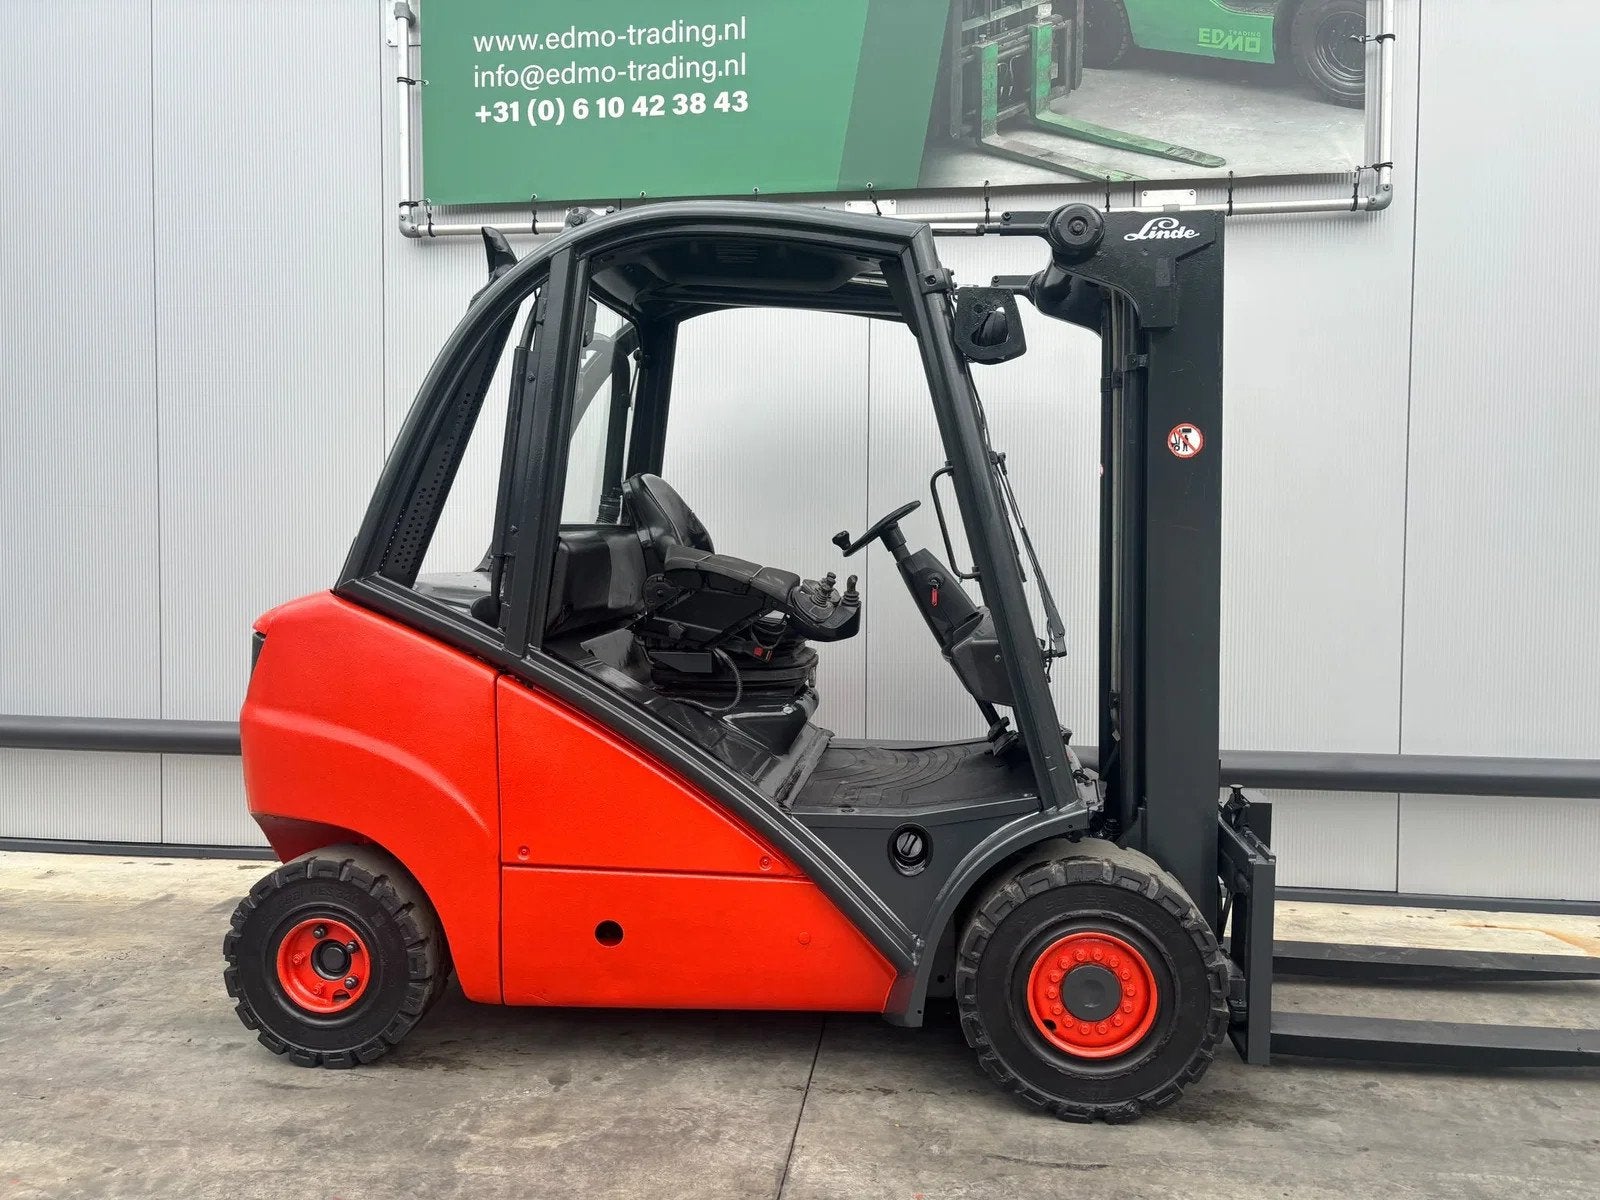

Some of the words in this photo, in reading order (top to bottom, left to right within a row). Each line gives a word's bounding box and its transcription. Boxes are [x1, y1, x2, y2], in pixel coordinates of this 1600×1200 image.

[473, 15, 746, 53] www.edmo-trading.nl
[1197, 27, 1261, 53] EDMO
[474, 51, 746, 91] info@edmo-trading.nl
[475, 100, 520, 123] +31
[527, 97, 565, 126] (0)
[572, 97, 590, 120] 6
[595, 96, 625, 118] 10
[631, 94, 666, 117] 42
[672, 92, 707, 115] 38
[713, 90, 749, 113] 43
[1123, 216, 1200, 241] Linde
